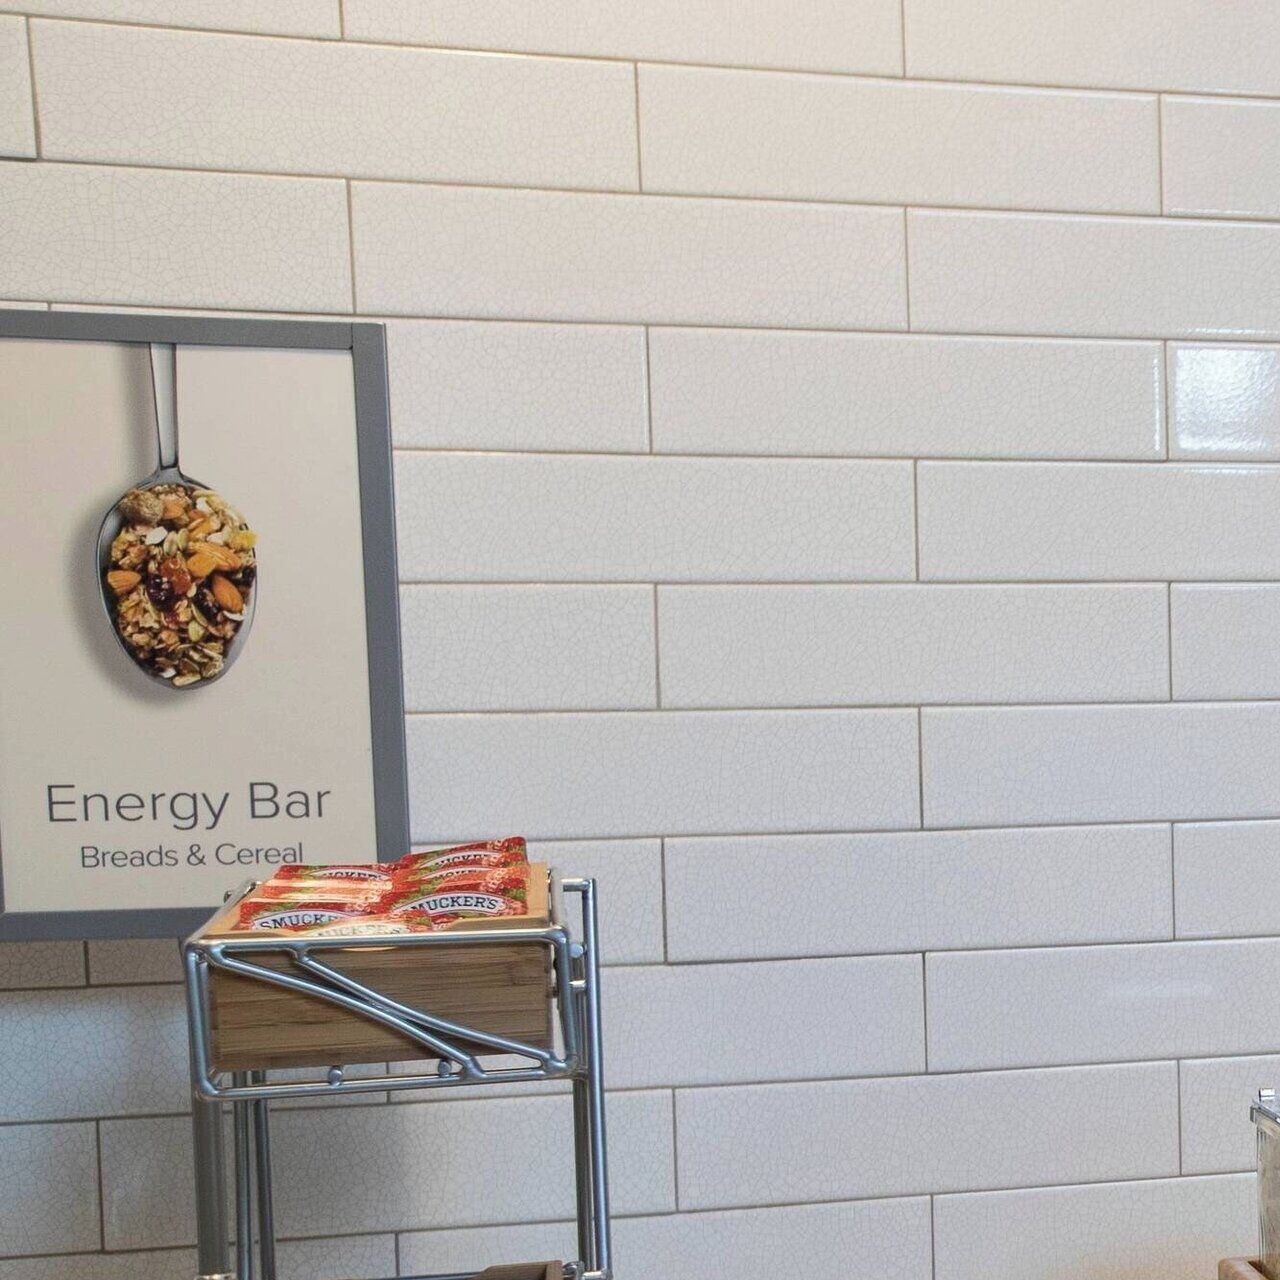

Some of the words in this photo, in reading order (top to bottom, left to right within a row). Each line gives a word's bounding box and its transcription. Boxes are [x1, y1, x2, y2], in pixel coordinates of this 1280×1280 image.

[47, 784, 230, 830] Energy
[249, 781, 332, 819] Bar
[80, 844, 179, 869] Breads
[186, 844, 207, 867] &
[215, 842, 304, 866] Cereal
